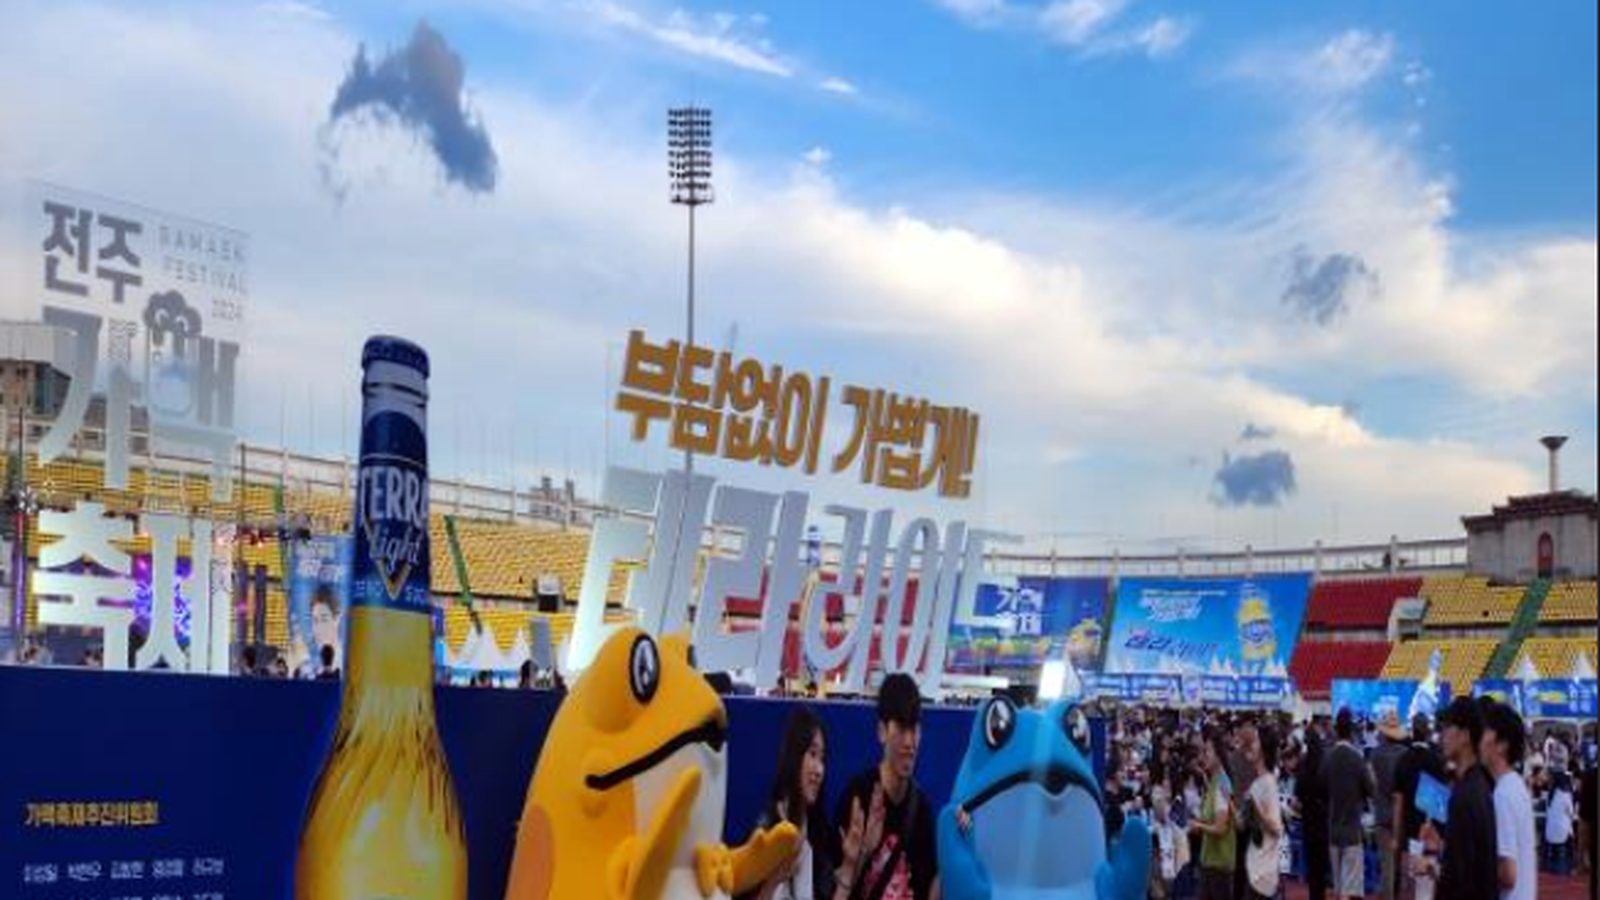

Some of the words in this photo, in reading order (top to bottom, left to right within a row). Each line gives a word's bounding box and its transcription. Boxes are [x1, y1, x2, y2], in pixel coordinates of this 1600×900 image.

[43, 200, 142, 303] 전주
[614, 330, 830, 475] 부담없이
[831, 384, 979, 498] 가볍게!
[32, 500, 229, 676] 축제
